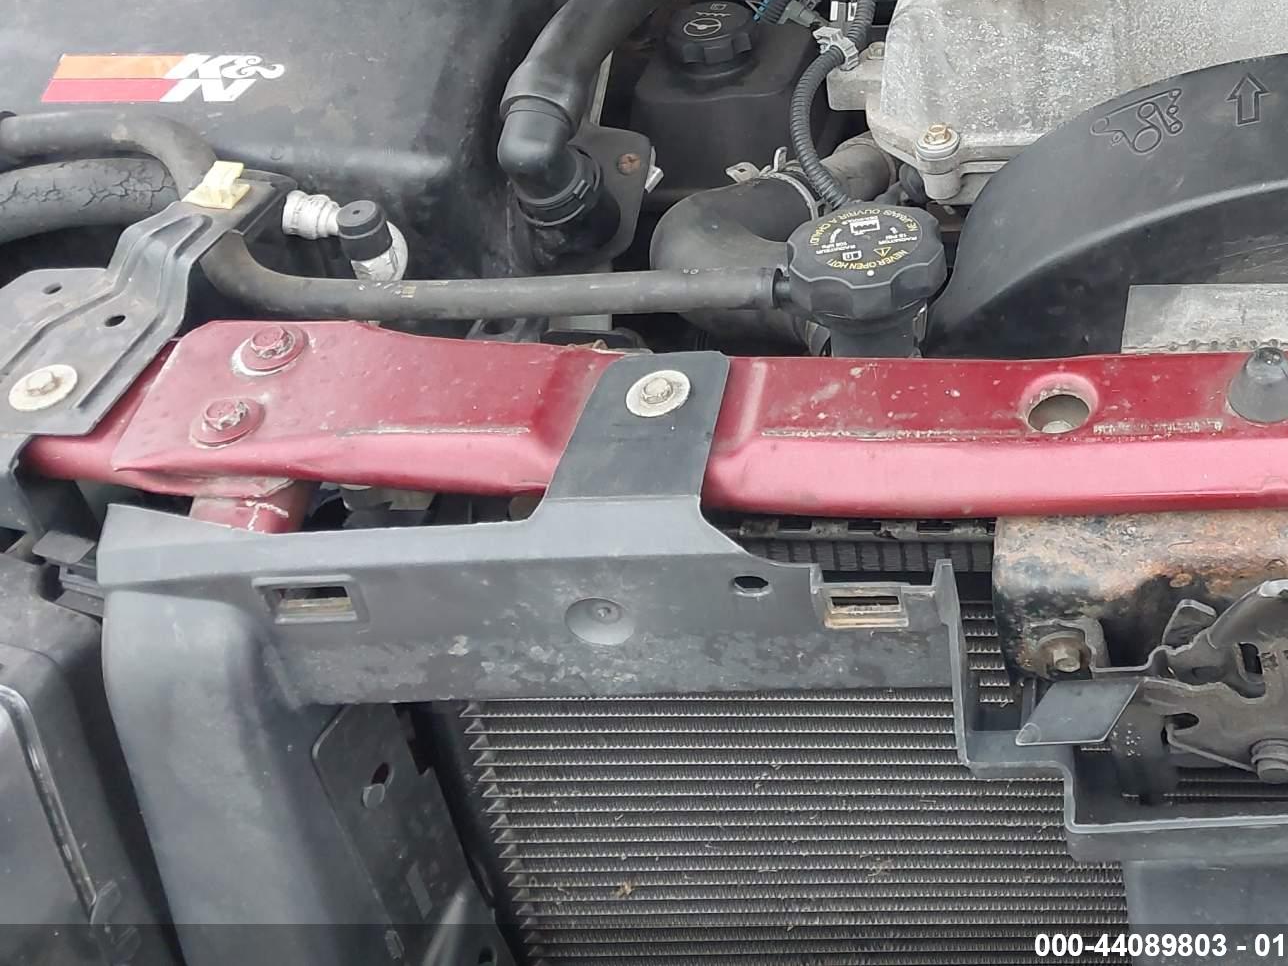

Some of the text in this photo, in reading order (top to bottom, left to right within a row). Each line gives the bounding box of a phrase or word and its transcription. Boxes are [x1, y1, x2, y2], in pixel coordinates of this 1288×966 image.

[159, 54, 285, 102] K&N
[826, 249, 909, 270] NEVER OPEN HOT!
